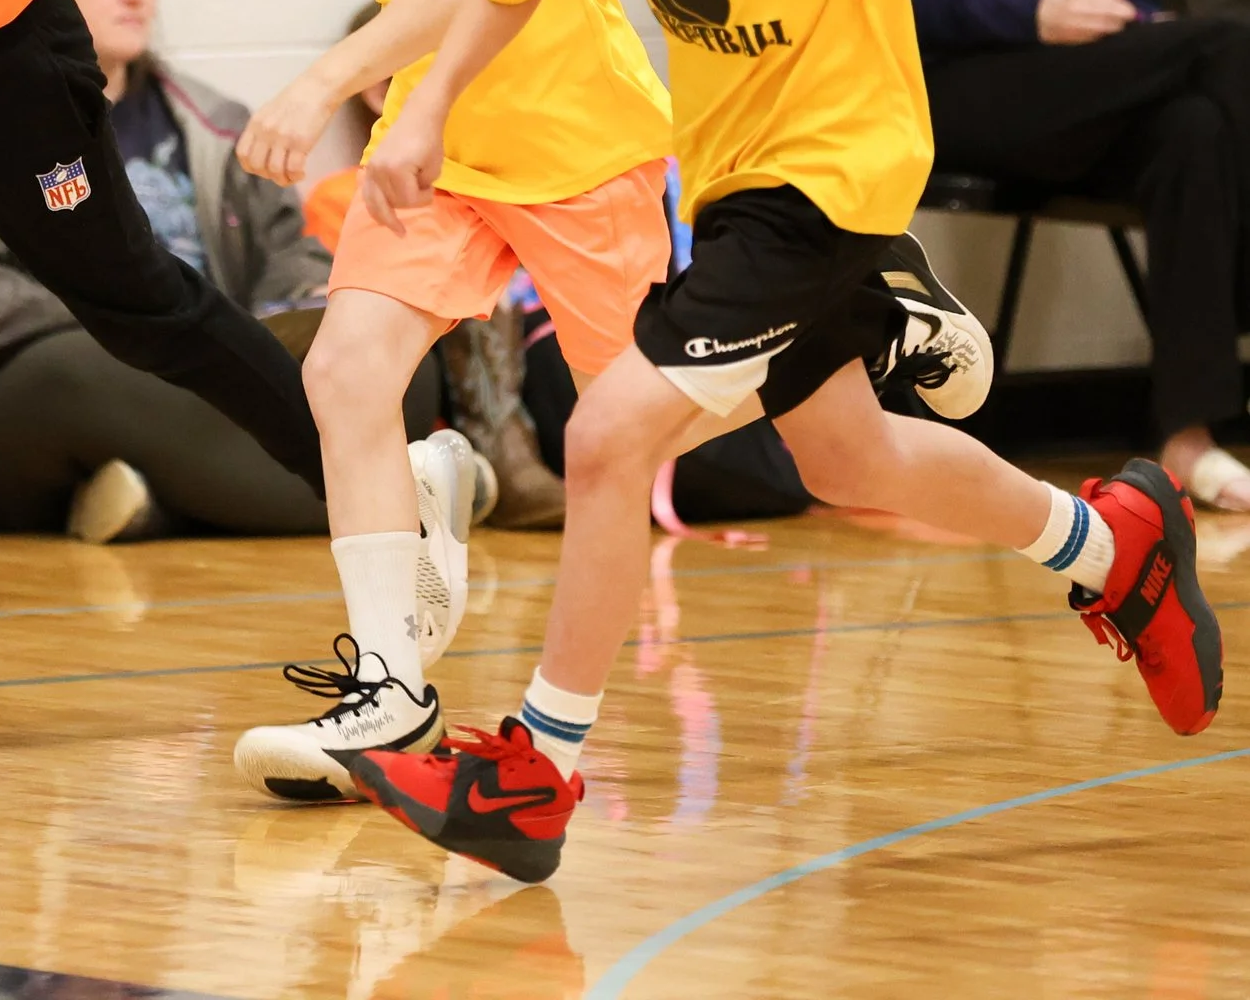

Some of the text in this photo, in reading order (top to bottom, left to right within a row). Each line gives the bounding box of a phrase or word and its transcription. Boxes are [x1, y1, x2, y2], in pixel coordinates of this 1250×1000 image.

[47, 179, 87, 207] NFL
[684, 322, 798, 358] Champion
[1140, 551, 1173, 606] NIKE
